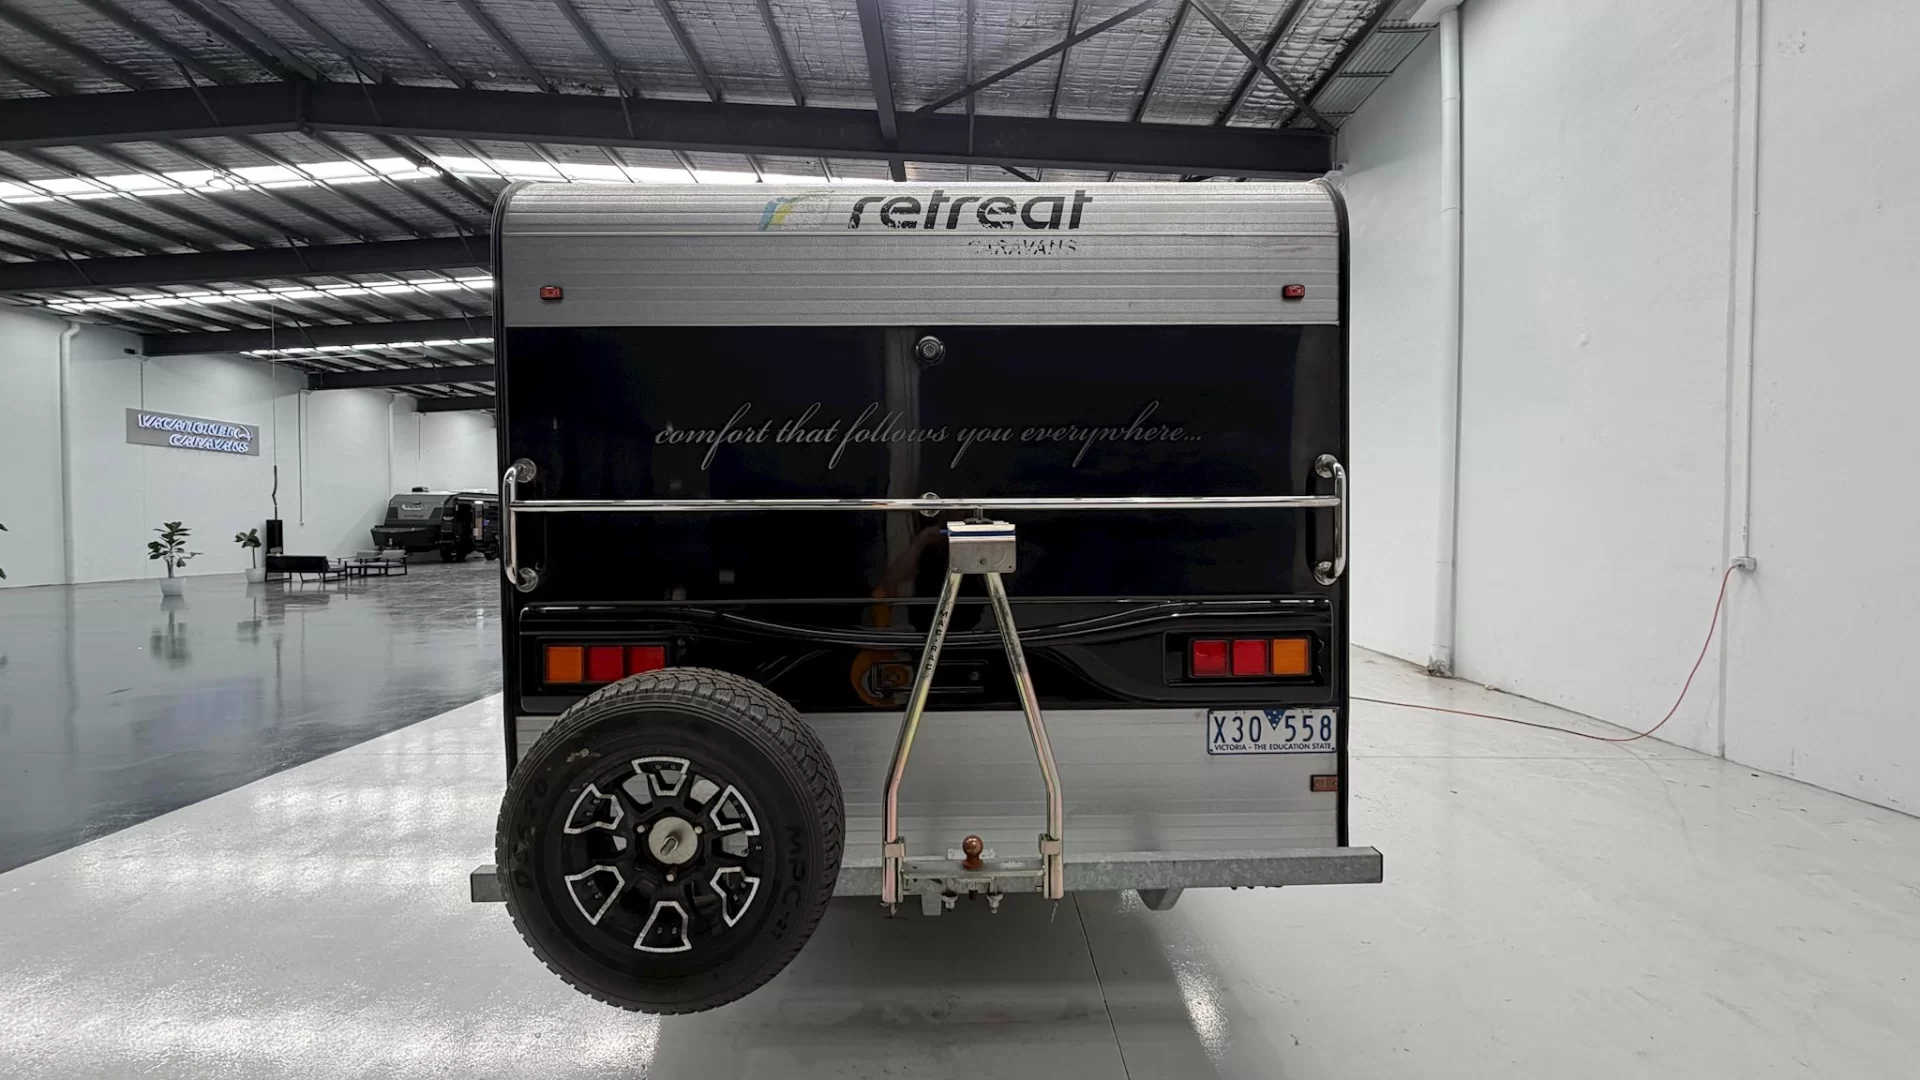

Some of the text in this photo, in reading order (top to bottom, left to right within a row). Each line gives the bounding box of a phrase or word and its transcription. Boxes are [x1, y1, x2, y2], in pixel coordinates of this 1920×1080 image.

[848, 190, 1093, 230] retreat
[968, 239, 1078, 256] RAVANS
[169, 433, 249, 453] CARAVANS
[654, 402, 773, 471] comfort
[775, 402, 842, 444] that
[828, 402, 950, 470] follows
[950, 426, 1014, 469] you
[1213, 715, 1332, 743] X30 558
[1214, 743, 1247, 751] VICTORIA
[1269, 742, 1310, 750] EDUCATION
[1312, 742, 1332, 750] STATE
